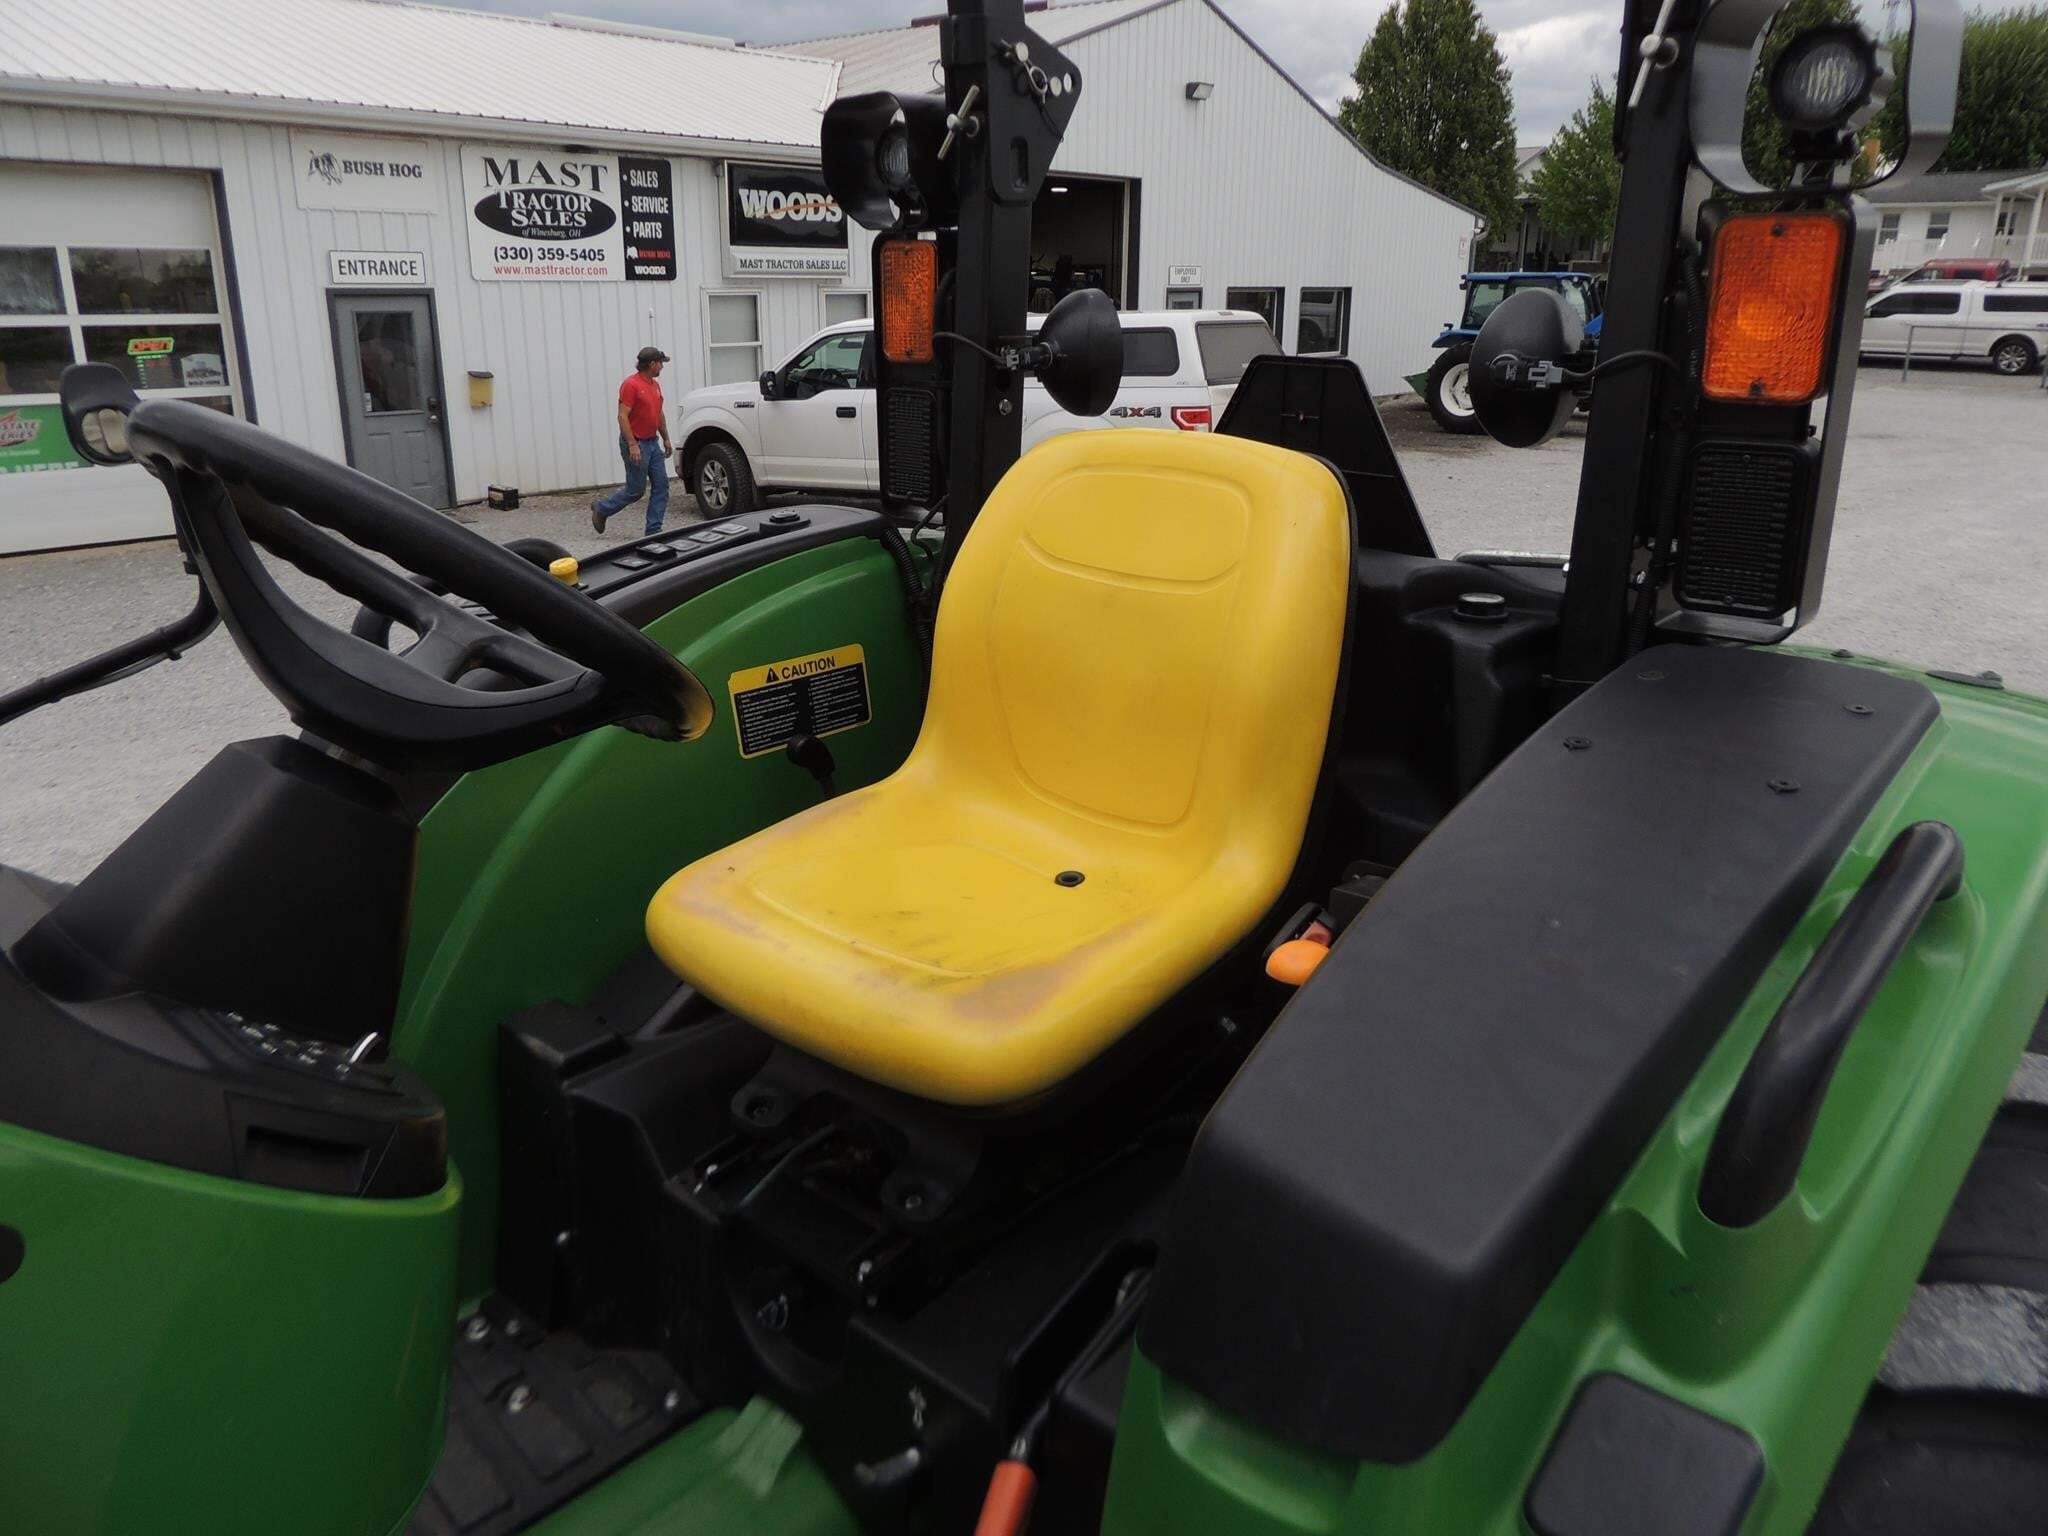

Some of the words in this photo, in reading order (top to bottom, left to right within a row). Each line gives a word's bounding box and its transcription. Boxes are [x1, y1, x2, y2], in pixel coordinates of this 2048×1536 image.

[342, 160, 385, 176] BUSH
[389, 163, 423, 178] HOG
[482, 157, 607, 193] MAST
[630, 169, 659, 188] SALES
[496, 189, 593, 213] TRACTOR
[631, 196, 669, 214] SERVICE
[738, 188, 842, 222] WOODS
[511, 208, 587, 227] SALES
[569, 229, 581, 237] OH
[633, 222, 662, 239] PARTS
[494, 246, 533, 263] (330)
[537, 247, 605, 261] 359-5405
[338, 259, 418, 276] ENTRANCE
[494, 265, 608, 276] www.masttractor.com
[634, 265, 666, 275] WOODS
[740, 259, 763, 269] MAST
[766, 259, 804, 270] TRACTOR
[806, 259, 830, 270] SALES
[832, 260, 846, 270] LLC
[781, 656, 836, 680] CAUTION
